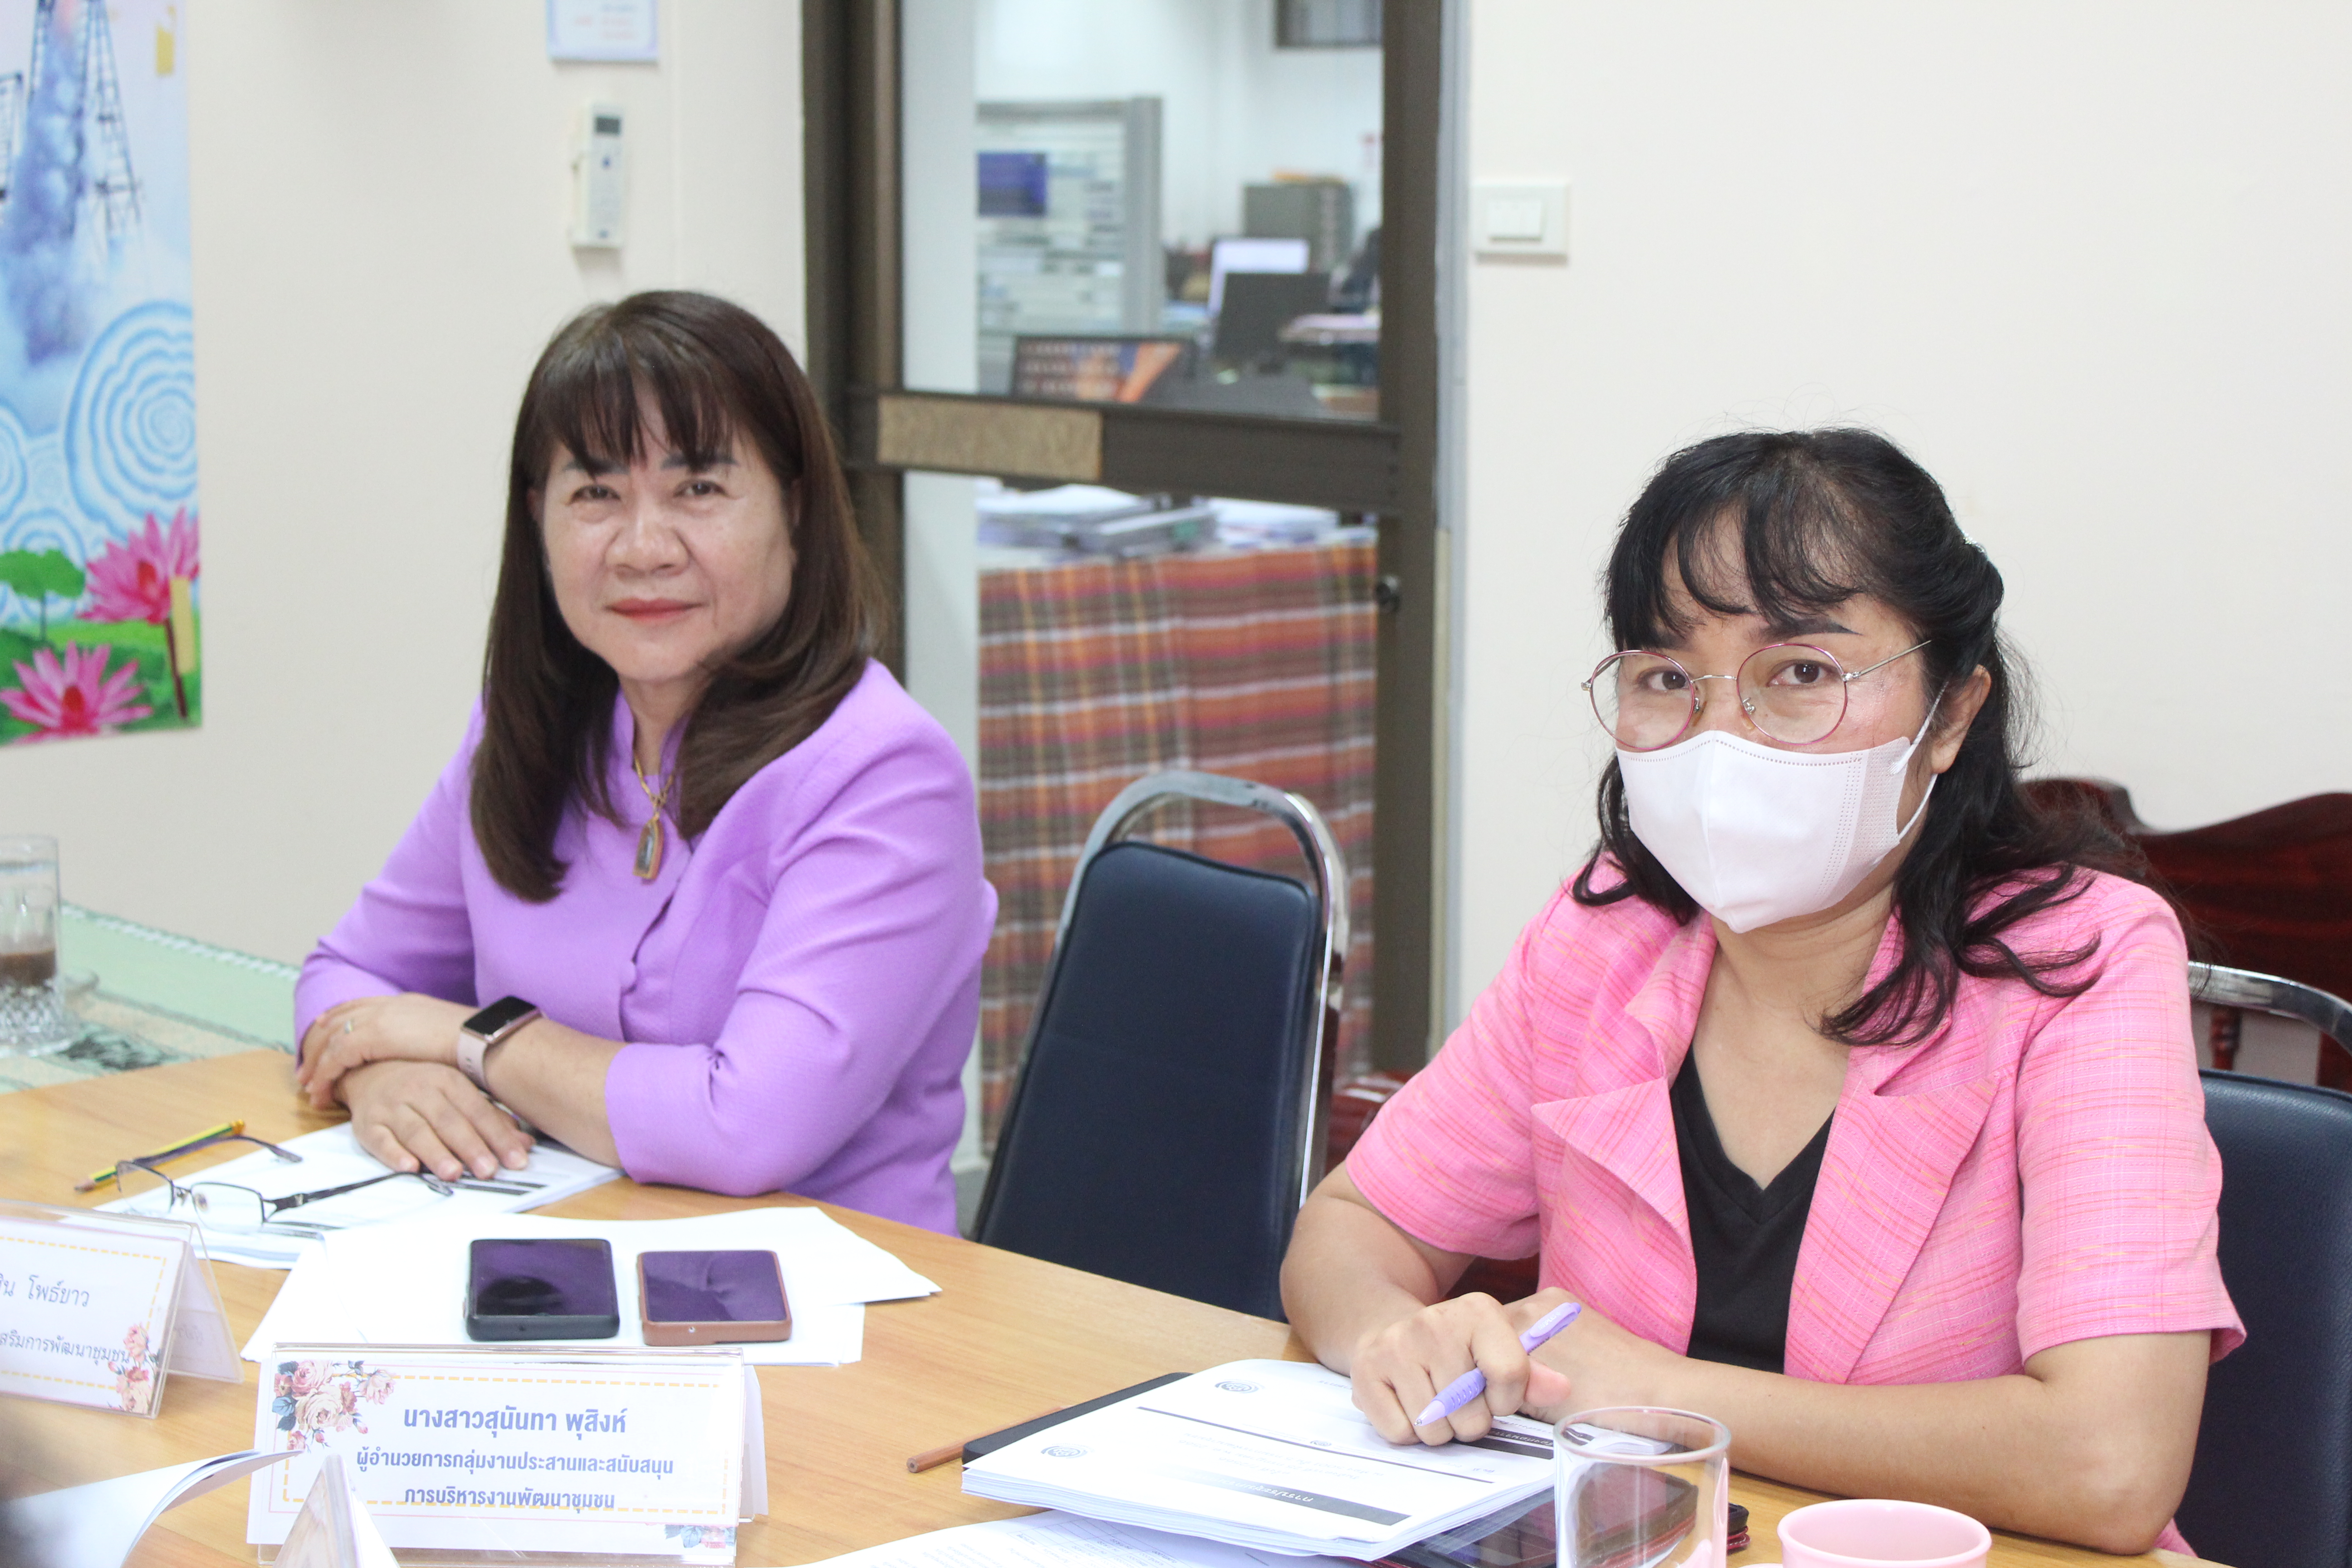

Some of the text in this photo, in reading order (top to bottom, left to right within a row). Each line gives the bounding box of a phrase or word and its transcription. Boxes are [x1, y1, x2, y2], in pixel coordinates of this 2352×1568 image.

[404, 1405, 628, 1441] นางสาวสุนันทา พุสิงห์
[357, 1446, 674, 1480] ผู้อำนวยการกลุ่มงานประสานและสนับสนุน
[404, 1486, 615, 1514] การบริหารงานพัฒนาชุมชน
